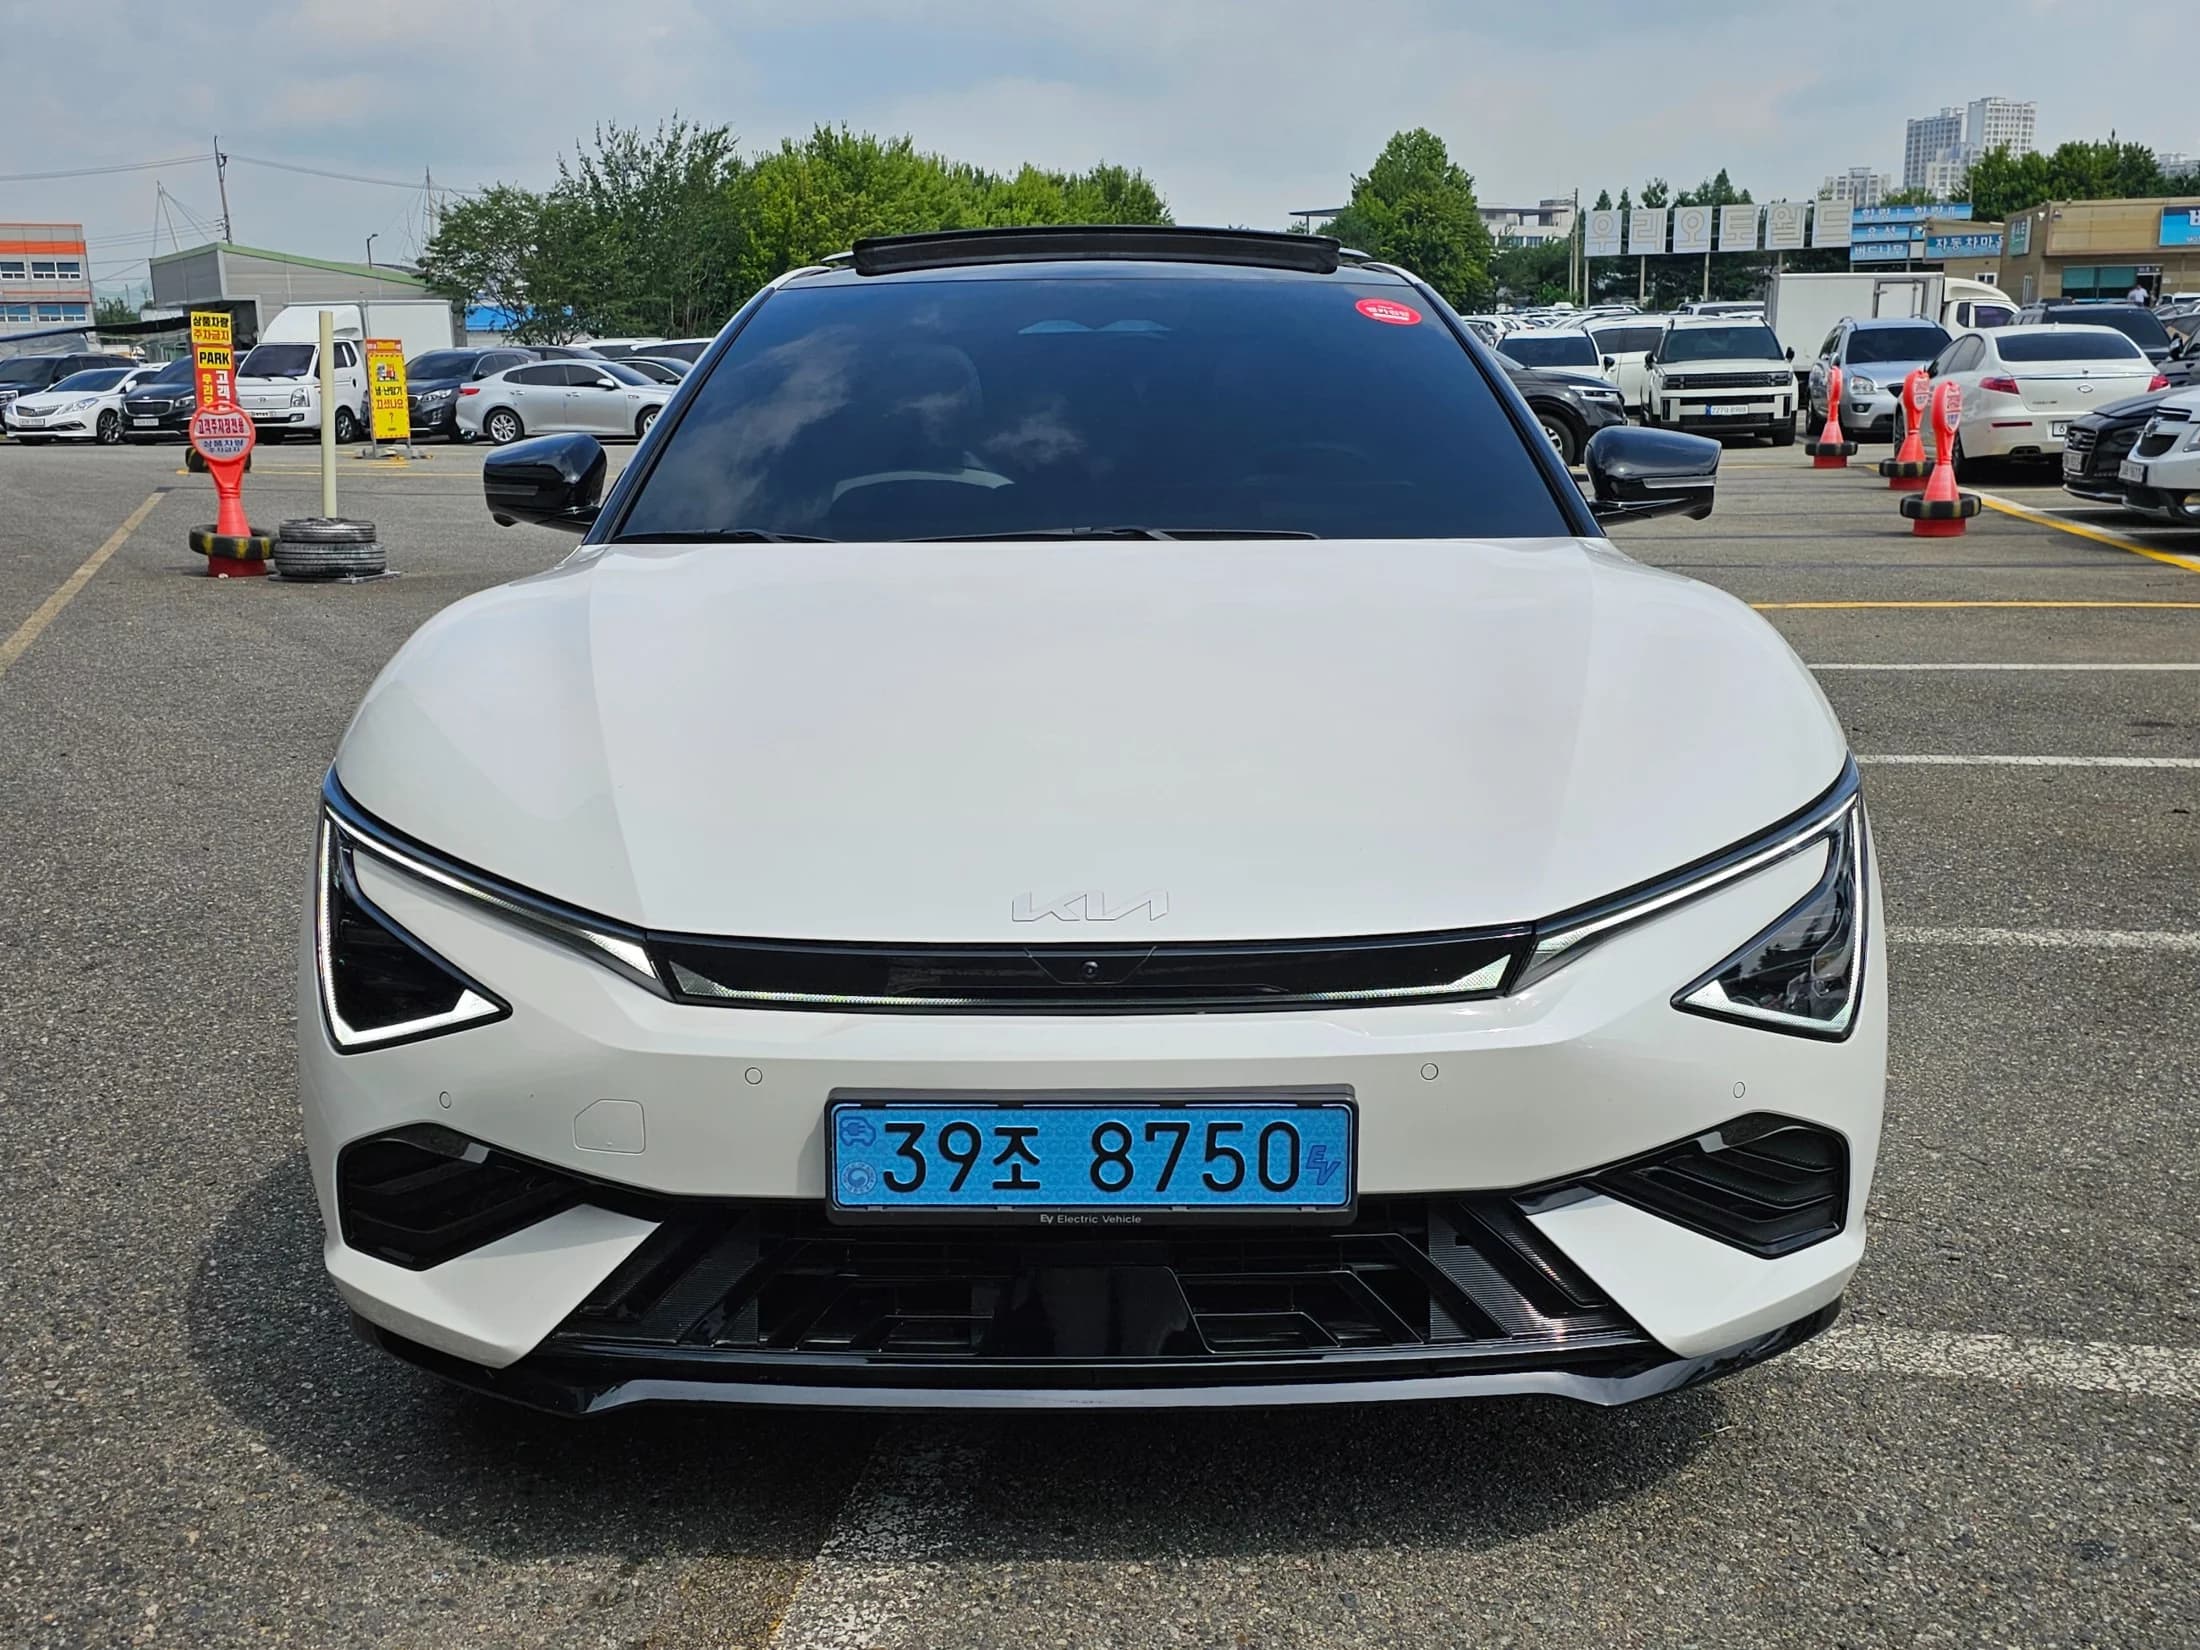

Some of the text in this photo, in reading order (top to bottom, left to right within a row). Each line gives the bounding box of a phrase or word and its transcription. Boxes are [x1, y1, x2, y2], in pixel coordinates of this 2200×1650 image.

[1587, 203, 1850, 250] 우리오토월드
[1855, 244, 1904, 257] 버드나무
[193, 316, 229, 328] 상품차량
[193, 329, 229, 341] 주차금지
[200, 352, 229, 365] PARK
[198, 417, 245, 434] 고객주차장전용
[883, 1120, 1301, 1193] 39조 8750
[1306, 1144, 1341, 1186] EV
[1057, 1214, 1099, 1224] Electric
[1102, 1214, 1142, 1224] Vehicle
